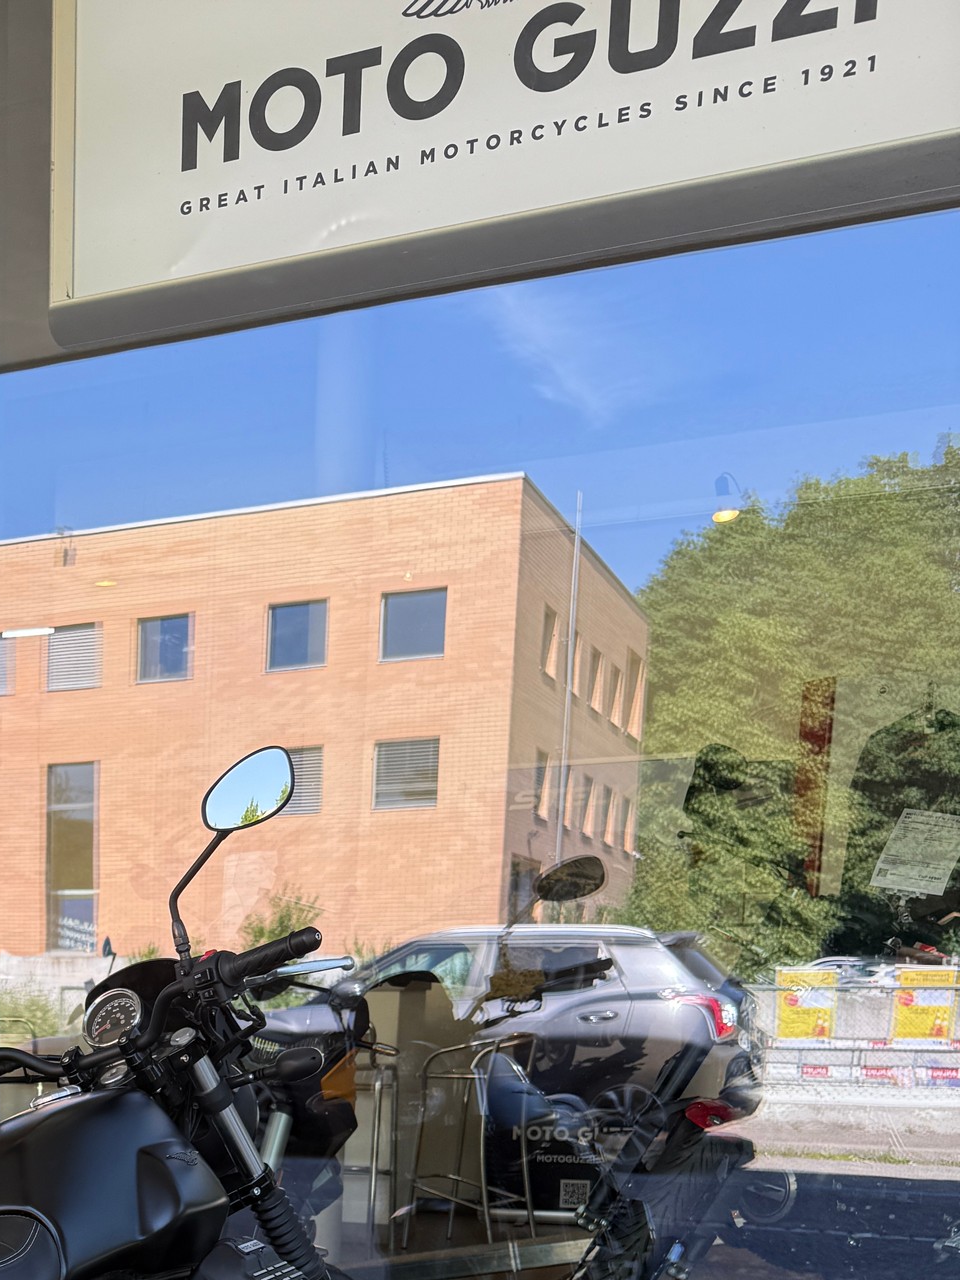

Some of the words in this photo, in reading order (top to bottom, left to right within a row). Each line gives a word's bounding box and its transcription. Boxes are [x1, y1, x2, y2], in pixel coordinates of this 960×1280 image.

[179, 184, 265, 216] GREAT
[283, 155, 400, 195] ITALIAN
[420, 102, 652, 165] MOTORCYCLES
[674, 75, 777, 112] SINCE
[801, 54, 876, 86] 1921
[181, 34, 466, 173] MOTO
[514, 0, 878, 93] GUZ
[512, 1125, 570, 1141] MOTO
